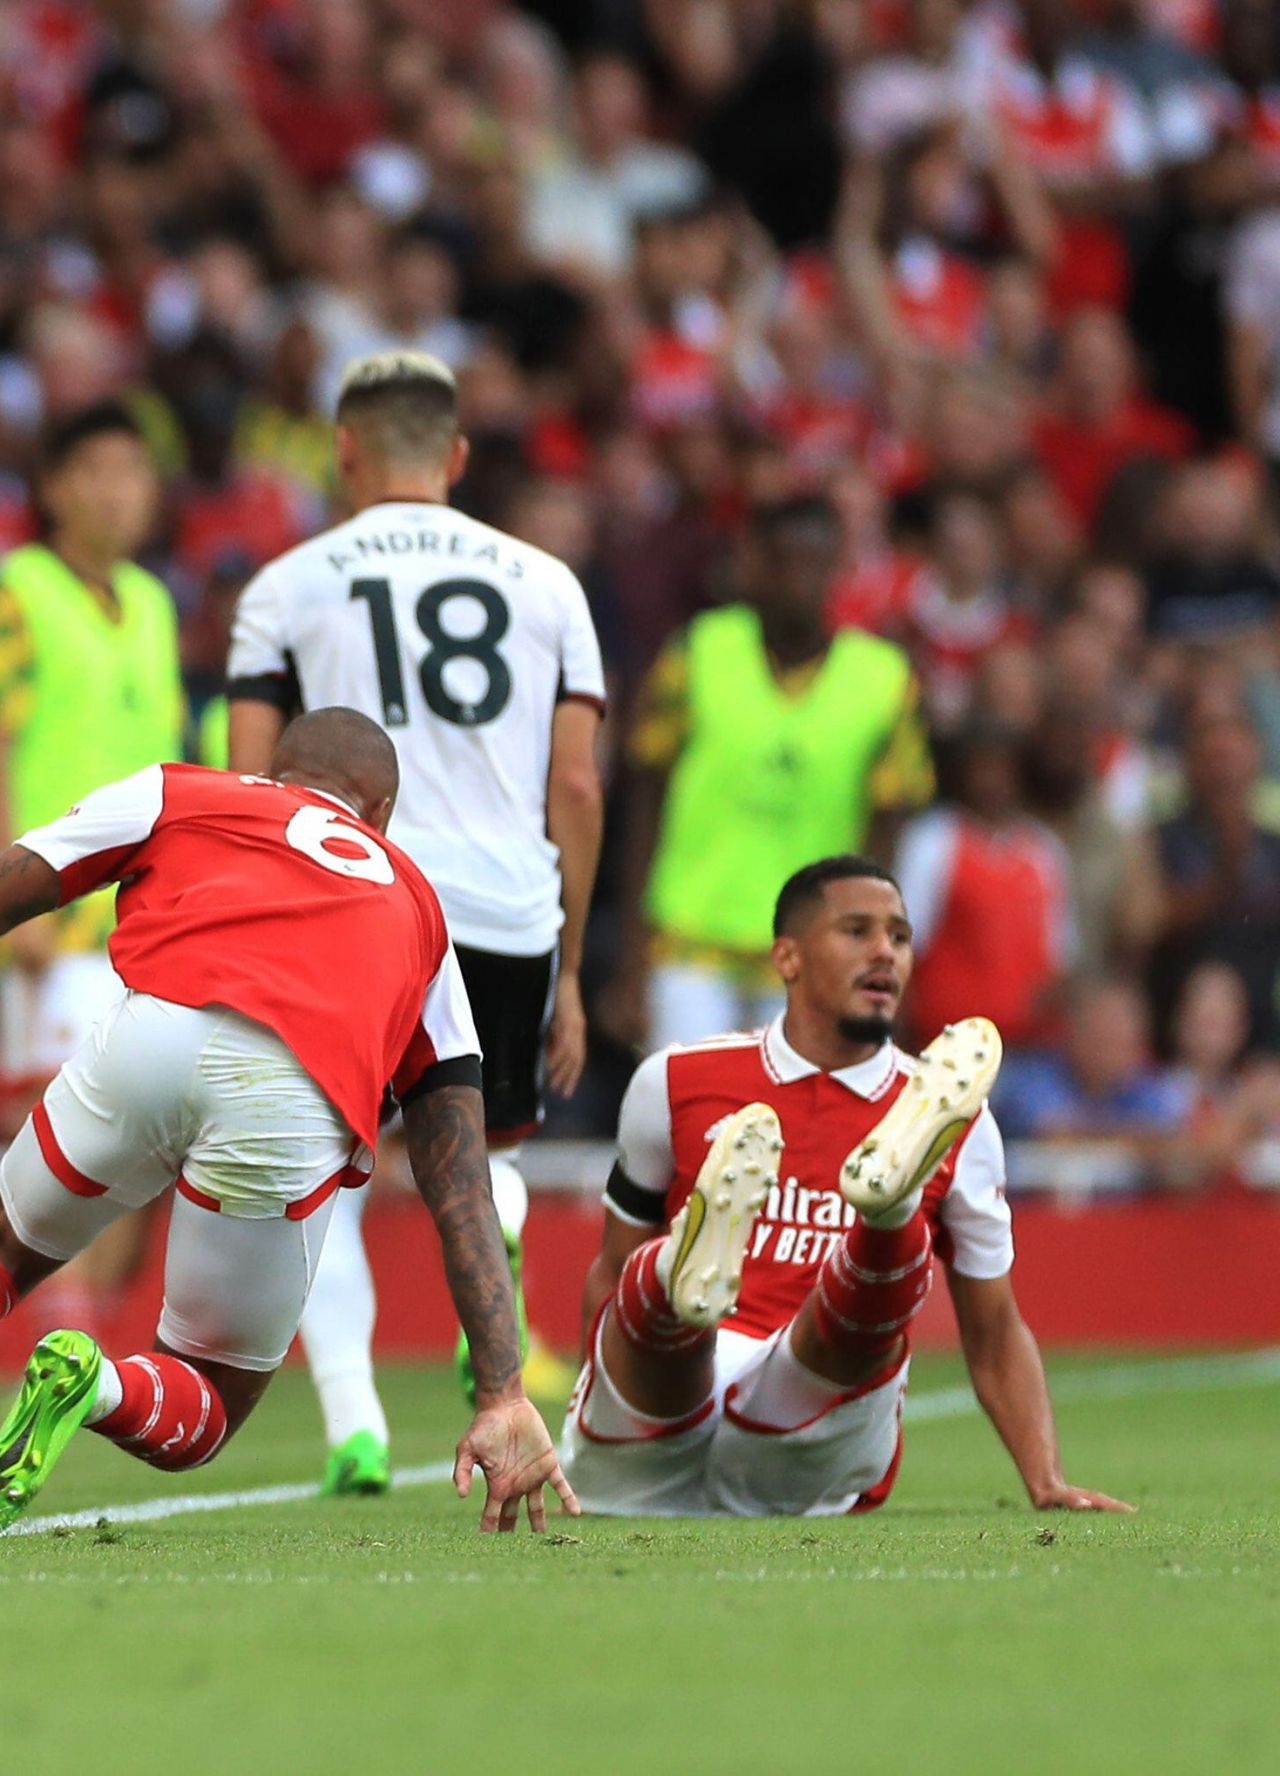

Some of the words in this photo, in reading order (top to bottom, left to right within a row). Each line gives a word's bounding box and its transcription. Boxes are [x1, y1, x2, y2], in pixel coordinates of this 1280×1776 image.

[327, 529, 525, 578] ANDREAS
[350, 578, 511, 727] 18
[285, 805, 395, 885] 6
[774, 1227, 843, 1265] BETT
